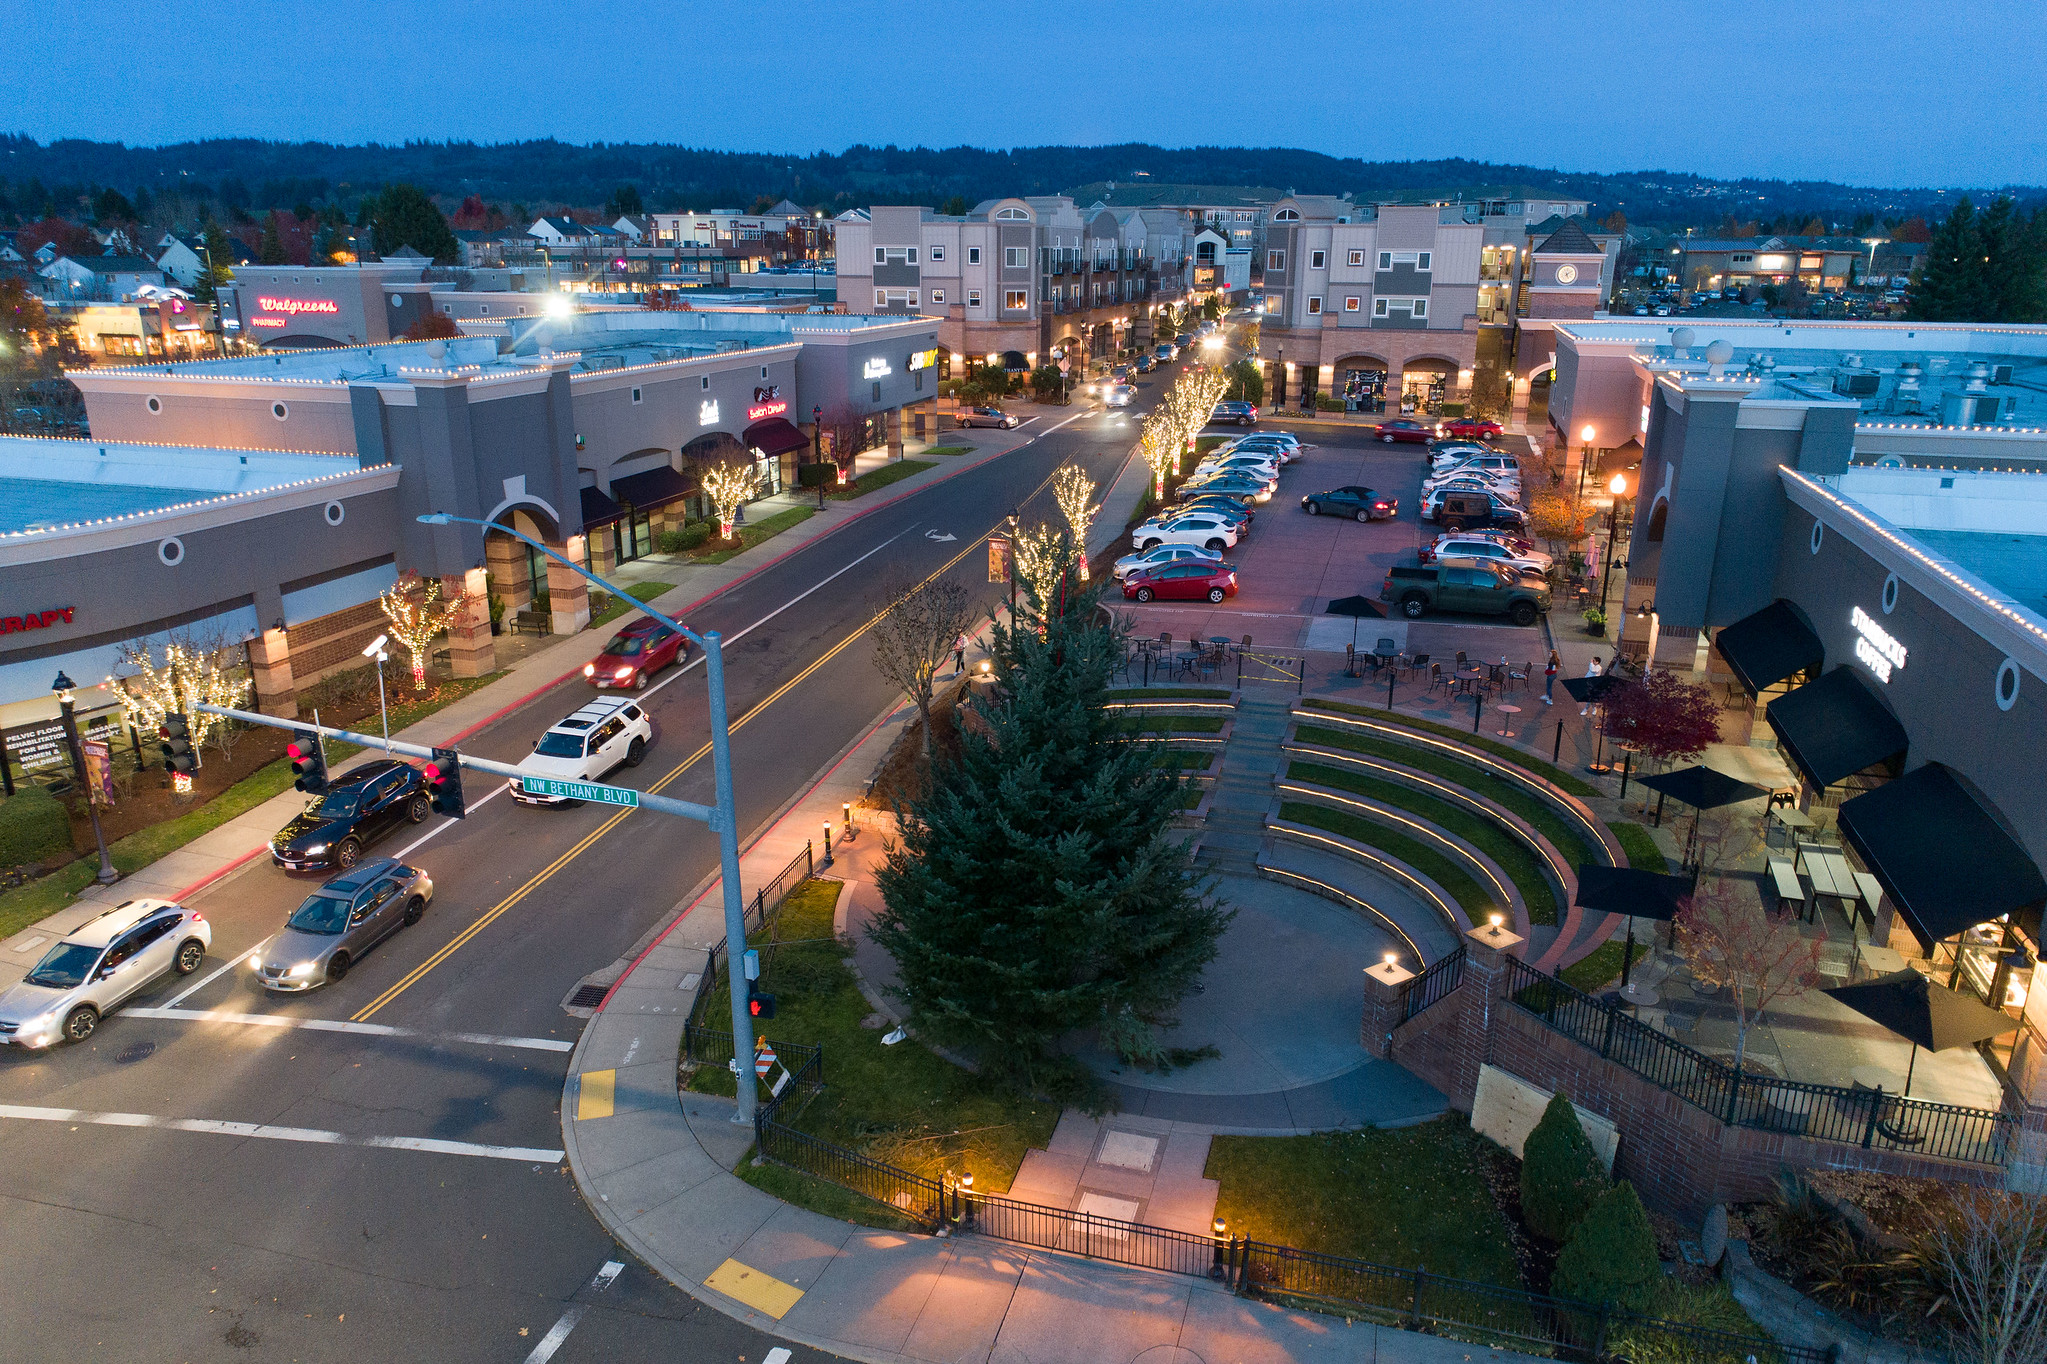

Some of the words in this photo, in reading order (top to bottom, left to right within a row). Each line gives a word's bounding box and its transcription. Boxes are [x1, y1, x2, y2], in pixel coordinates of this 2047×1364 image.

[259, 297, 338, 315] Walgreens
[252, 318, 287, 328] PHARMACY
[749, 408, 768, 419] Salon
[0, 606, 75, 635] RAPY
[1851, 606, 1908, 669] STARBUCKS
[1856, 636, 1892, 684] COFFEE
[6, 732, 36, 742] PELVIC
[36, 725, 65, 736] FLOOR
[83, 722, 120, 736] MASSAGE
[85, 730, 120, 742] THERAPY
[6, 732, 67, 750] REHABILITATION
[19, 746, 37, 755] FOR
[20, 750, 52, 762] WOMEN
[21, 755, 63, 769] CHILDREN
[529, 778, 545, 792] NW
[550, 781, 599, 799] BETHANY
[603, 788, 631, 804] BLVD
